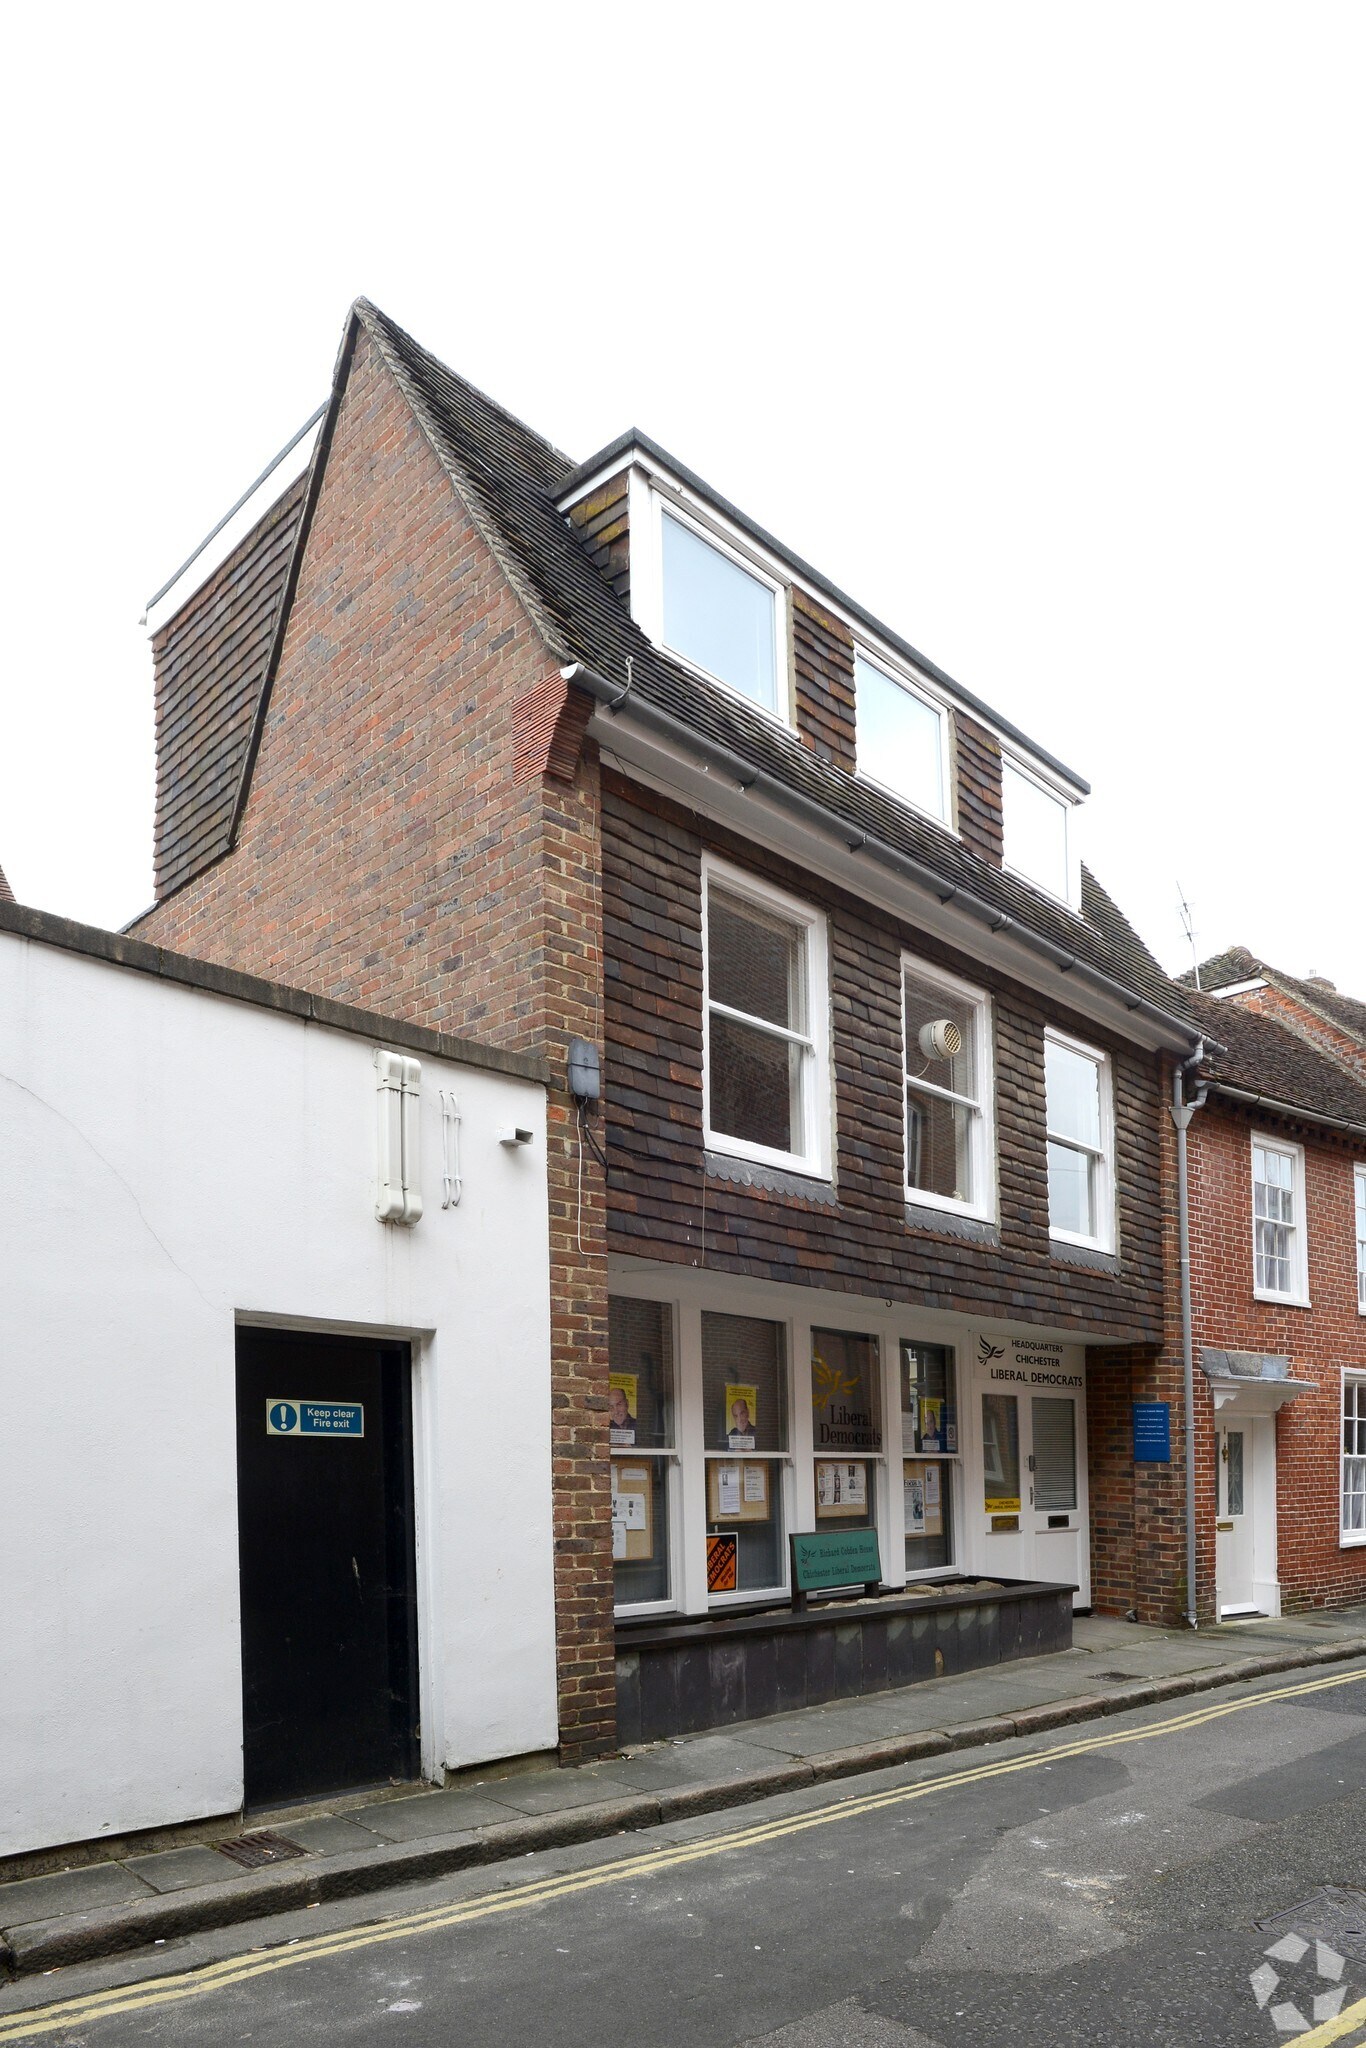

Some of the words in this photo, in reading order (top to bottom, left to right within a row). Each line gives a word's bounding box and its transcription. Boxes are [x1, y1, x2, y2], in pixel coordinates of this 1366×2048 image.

[1011, 1339, 1063, 1353] HEADQUARTERS
[1015, 1354, 1060, 1367] CHICHESTER
[990, 1368, 1028, 1382] LIBERAL
[1031, 1372, 1083, 1387] DEMOCRATS
[307, 1408, 331, 1419] Keep
[333, 1409, 355, 1418] clear
[830, 1404, 873, 1427] Liberal
[313, 1418, 331, 1428] Fire
[333, 1419, 350, 1428] exit
[819, 1423, 882, 1446] Democrats
[707, 1543, 726, 1573] IBERAL
[707, 1542, 735, 1586] EMOCRATS
[802, 1568, 830, 1579] Chichester
[831, 1564, 850, 1576] Liberal
[850, 1563, 876, 1573] Democrats
